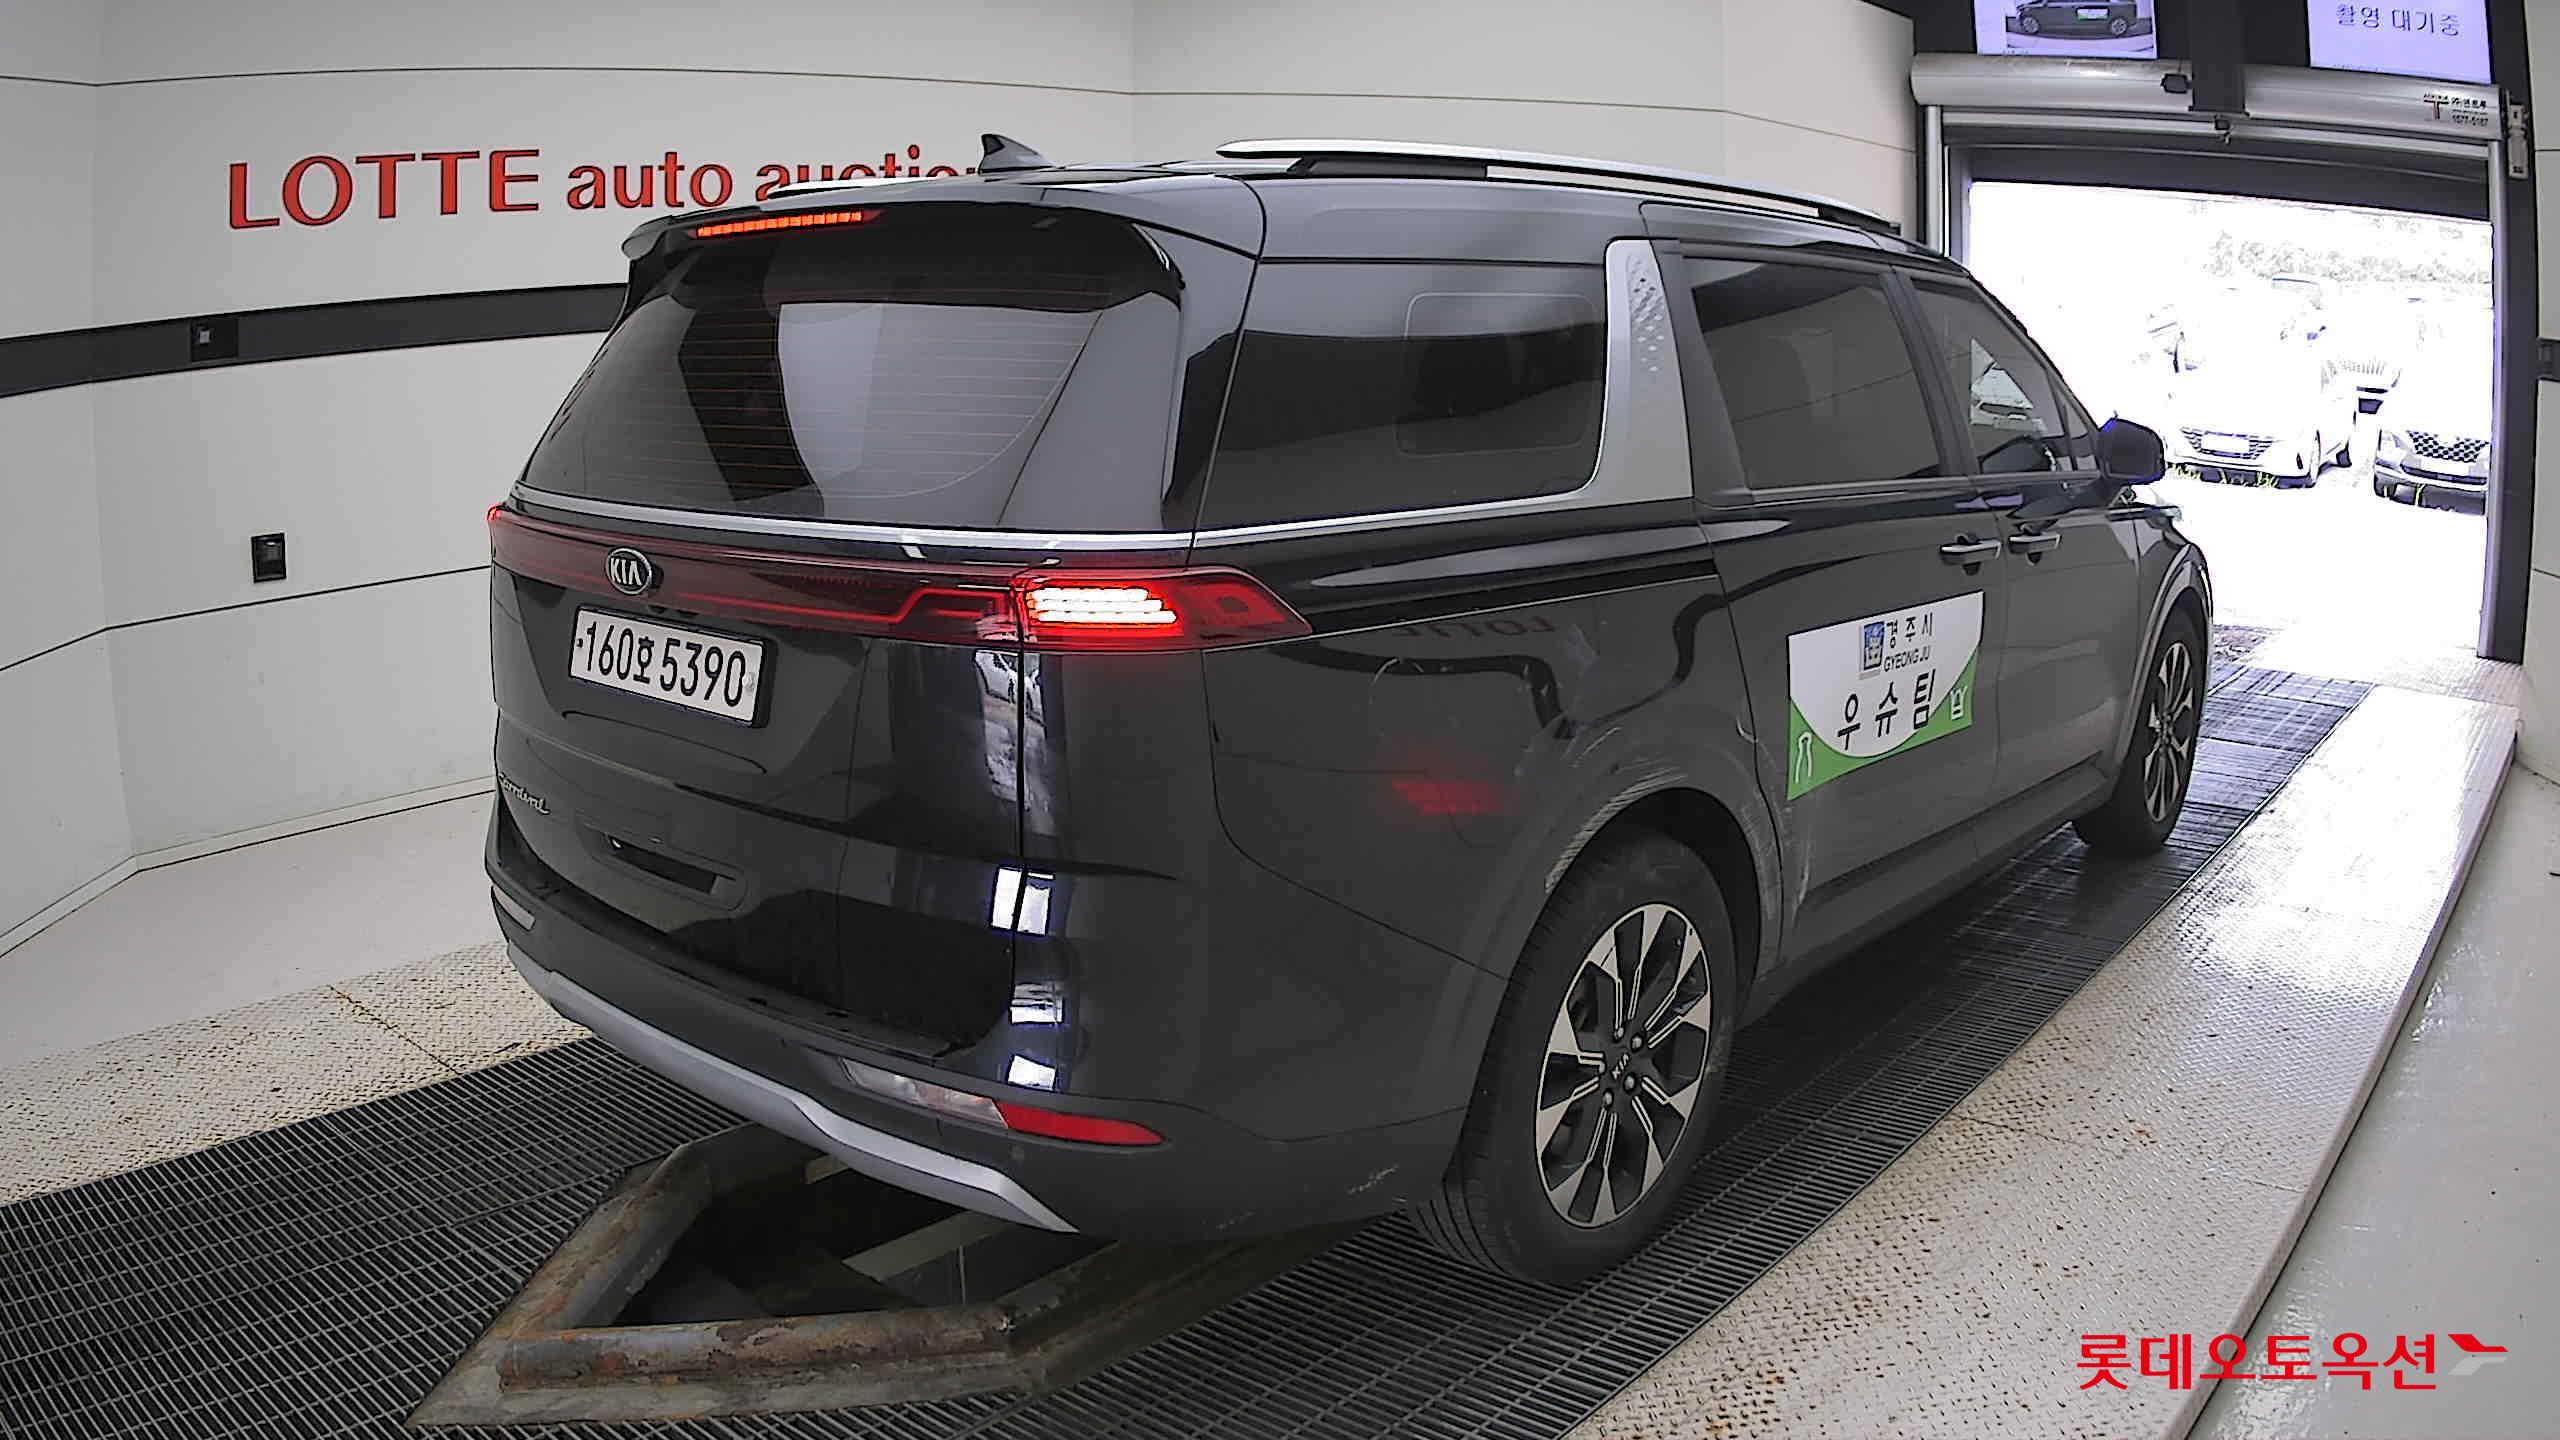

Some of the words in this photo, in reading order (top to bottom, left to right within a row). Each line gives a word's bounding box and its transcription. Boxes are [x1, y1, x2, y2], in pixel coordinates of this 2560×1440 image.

[2391, 9, 2459, 37] 대기중
[229, 148, 540, 230] LOTTE
[566, 151, 734, 210] auto
[609, 556, 643, 587] KIA
[1886, 612, 1933, 649] 경주시
[659, 636, 746, 708] 5390
[1836, 668, 1937, 751] 우슈팀
